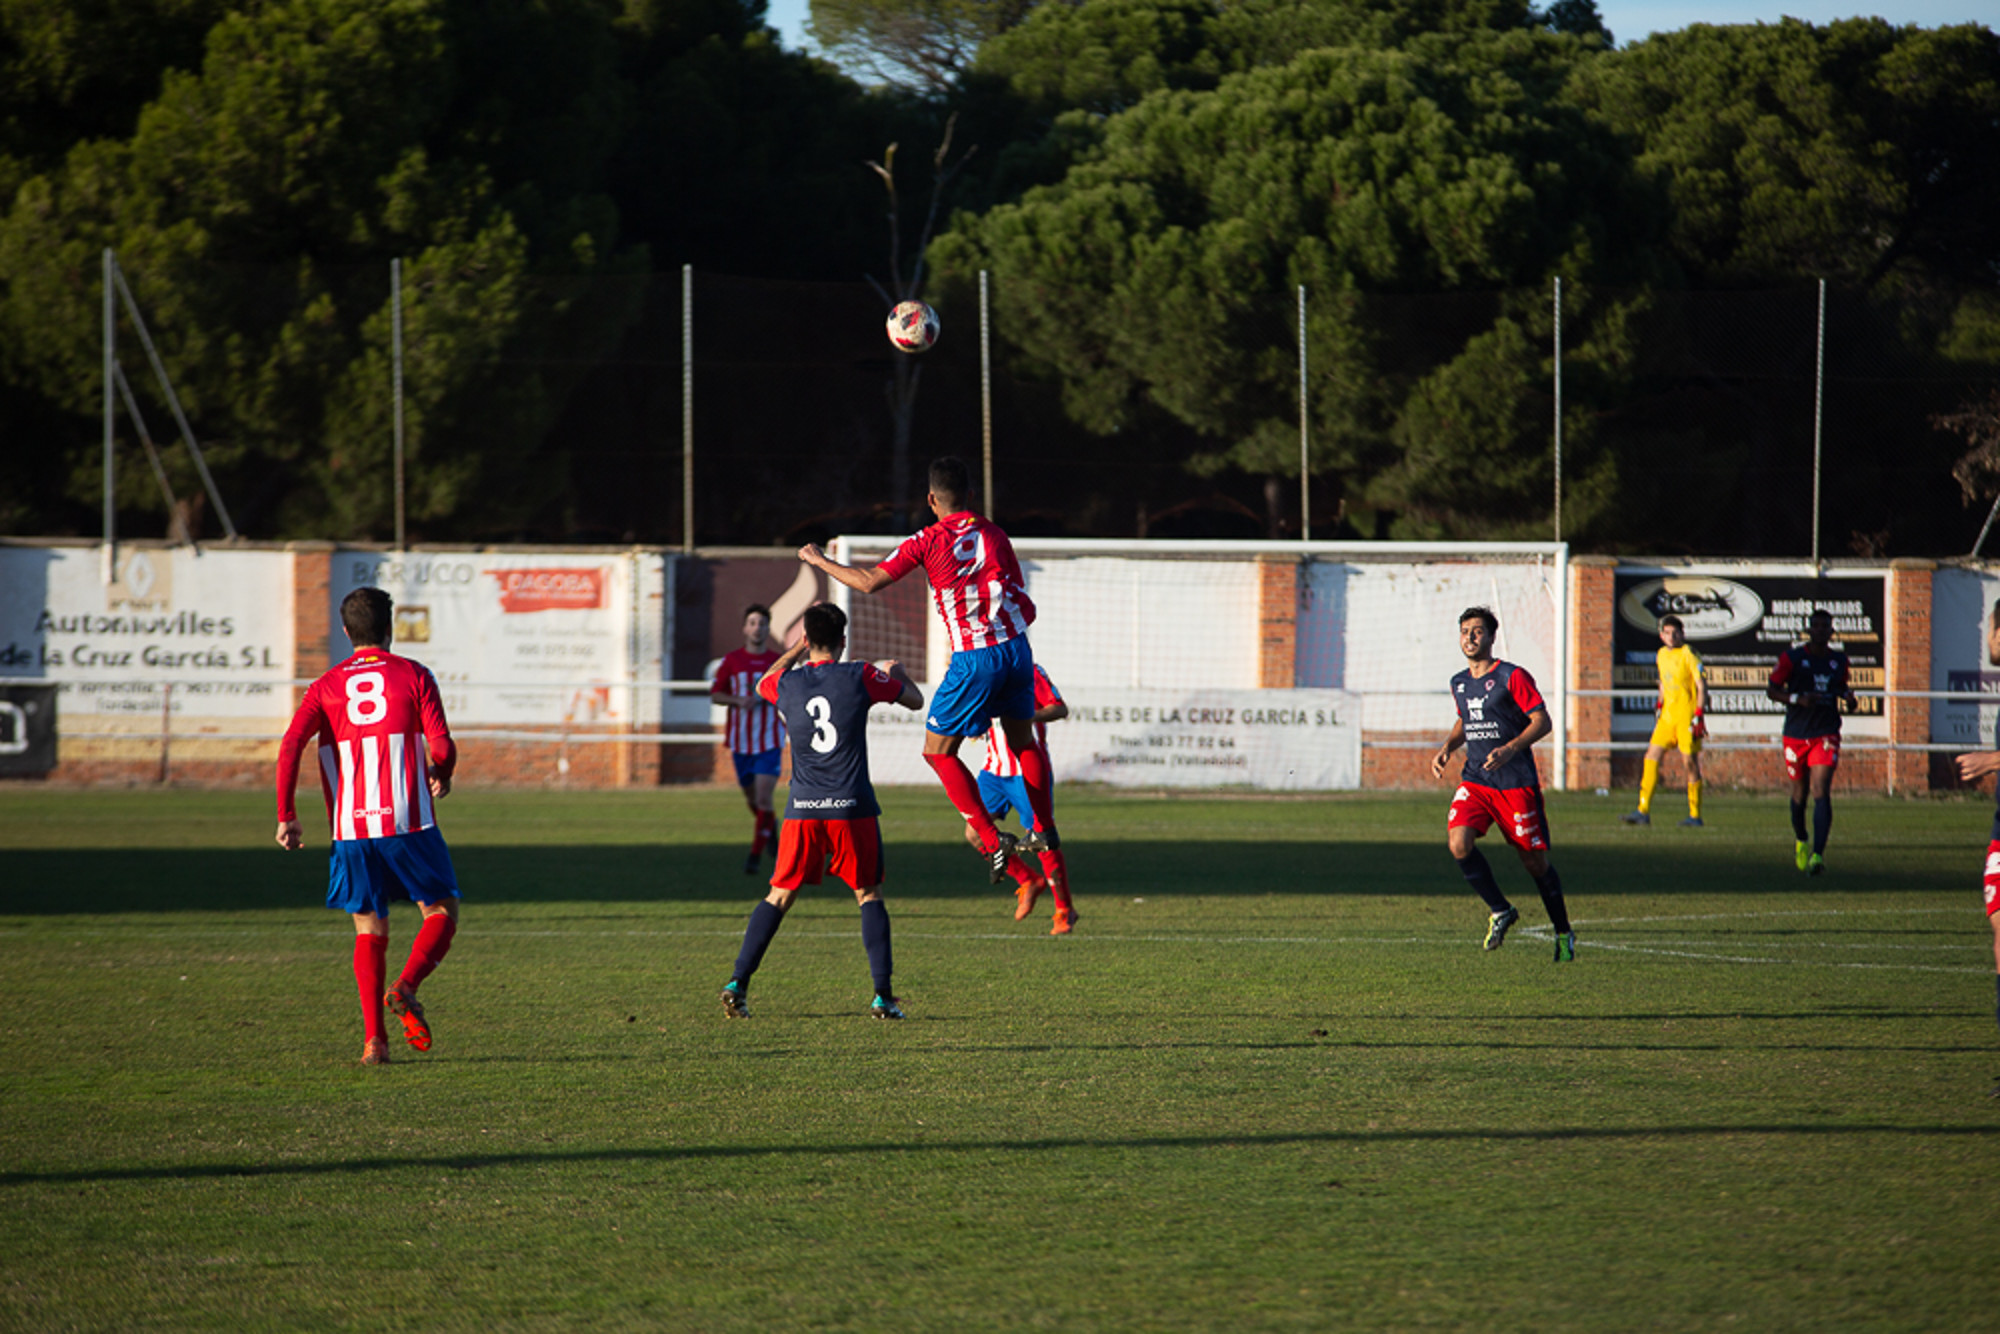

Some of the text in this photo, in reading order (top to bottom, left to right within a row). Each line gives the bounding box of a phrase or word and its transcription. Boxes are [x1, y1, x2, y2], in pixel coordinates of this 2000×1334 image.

[953, 531, 986, 577] 9
[0, 643, 32, 667] de
[41, 643, 64, 667] la
[71, 644, 132, 668] Cruz
[345, 671, 388, 726] 8
[1130, 707, 1150, 723] DE
[1159, 707, 1181, 724] LA
[1187, 708, 1234, 725] CRUZ
[805, 696, 838, 753] 3
